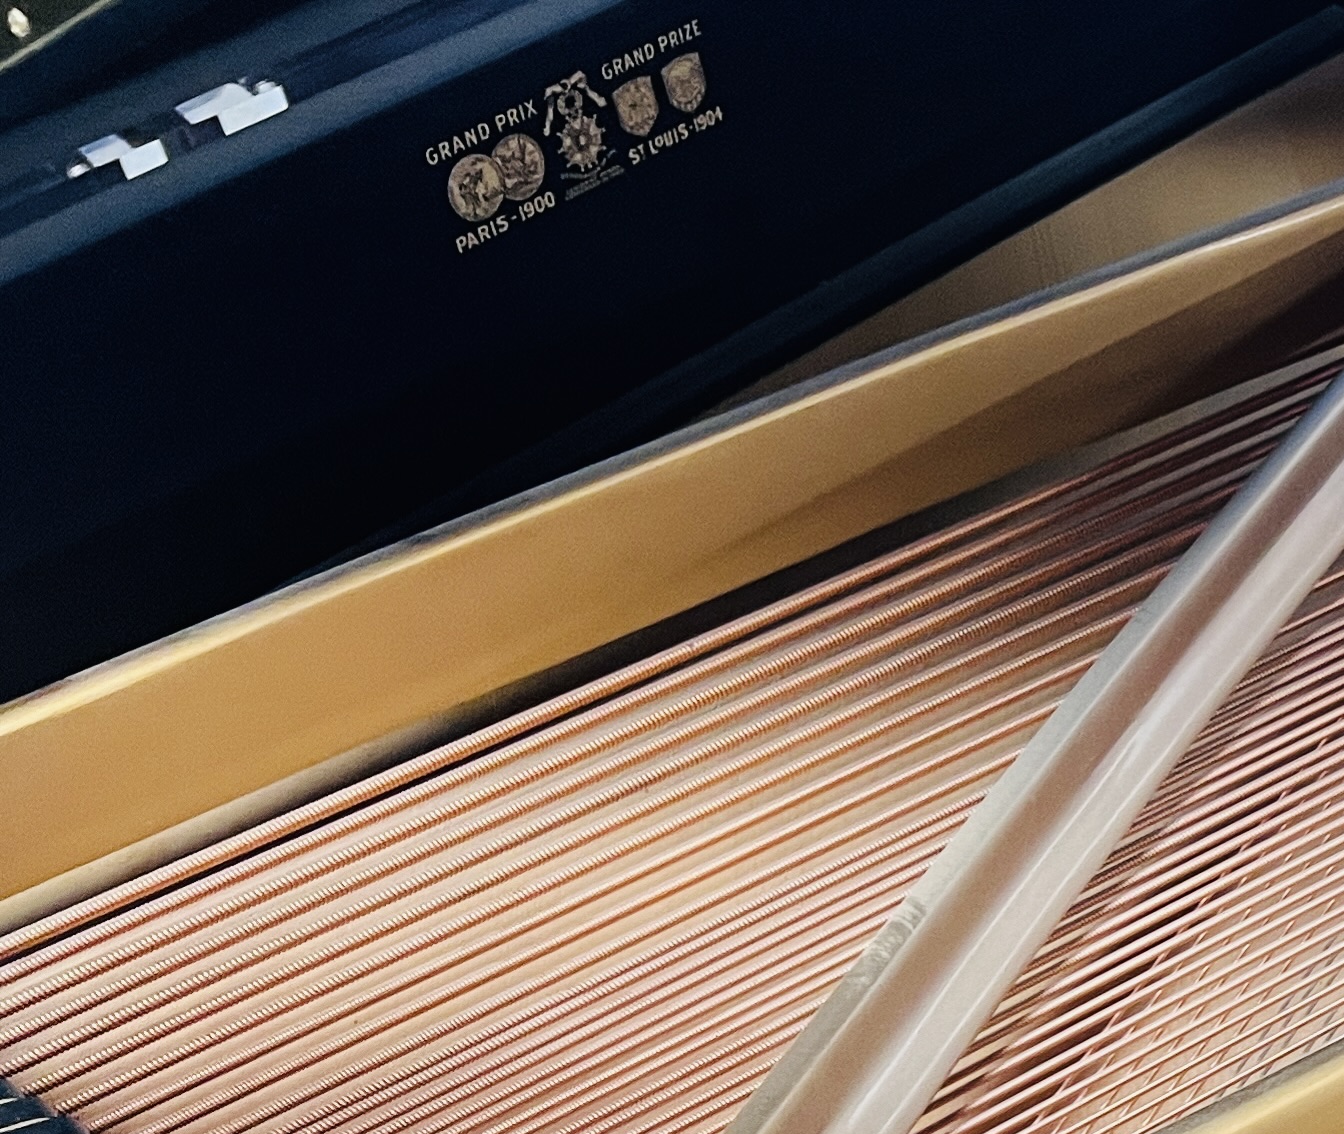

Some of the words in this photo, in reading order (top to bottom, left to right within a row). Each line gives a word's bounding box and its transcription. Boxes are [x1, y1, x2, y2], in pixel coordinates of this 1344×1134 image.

[602, 43, 654, 80] GRAND
[658, 20, 702, 53] PRIZE
[425, 123, 490, 166] GRAND
[494, 100, 537, 135] PRIX
